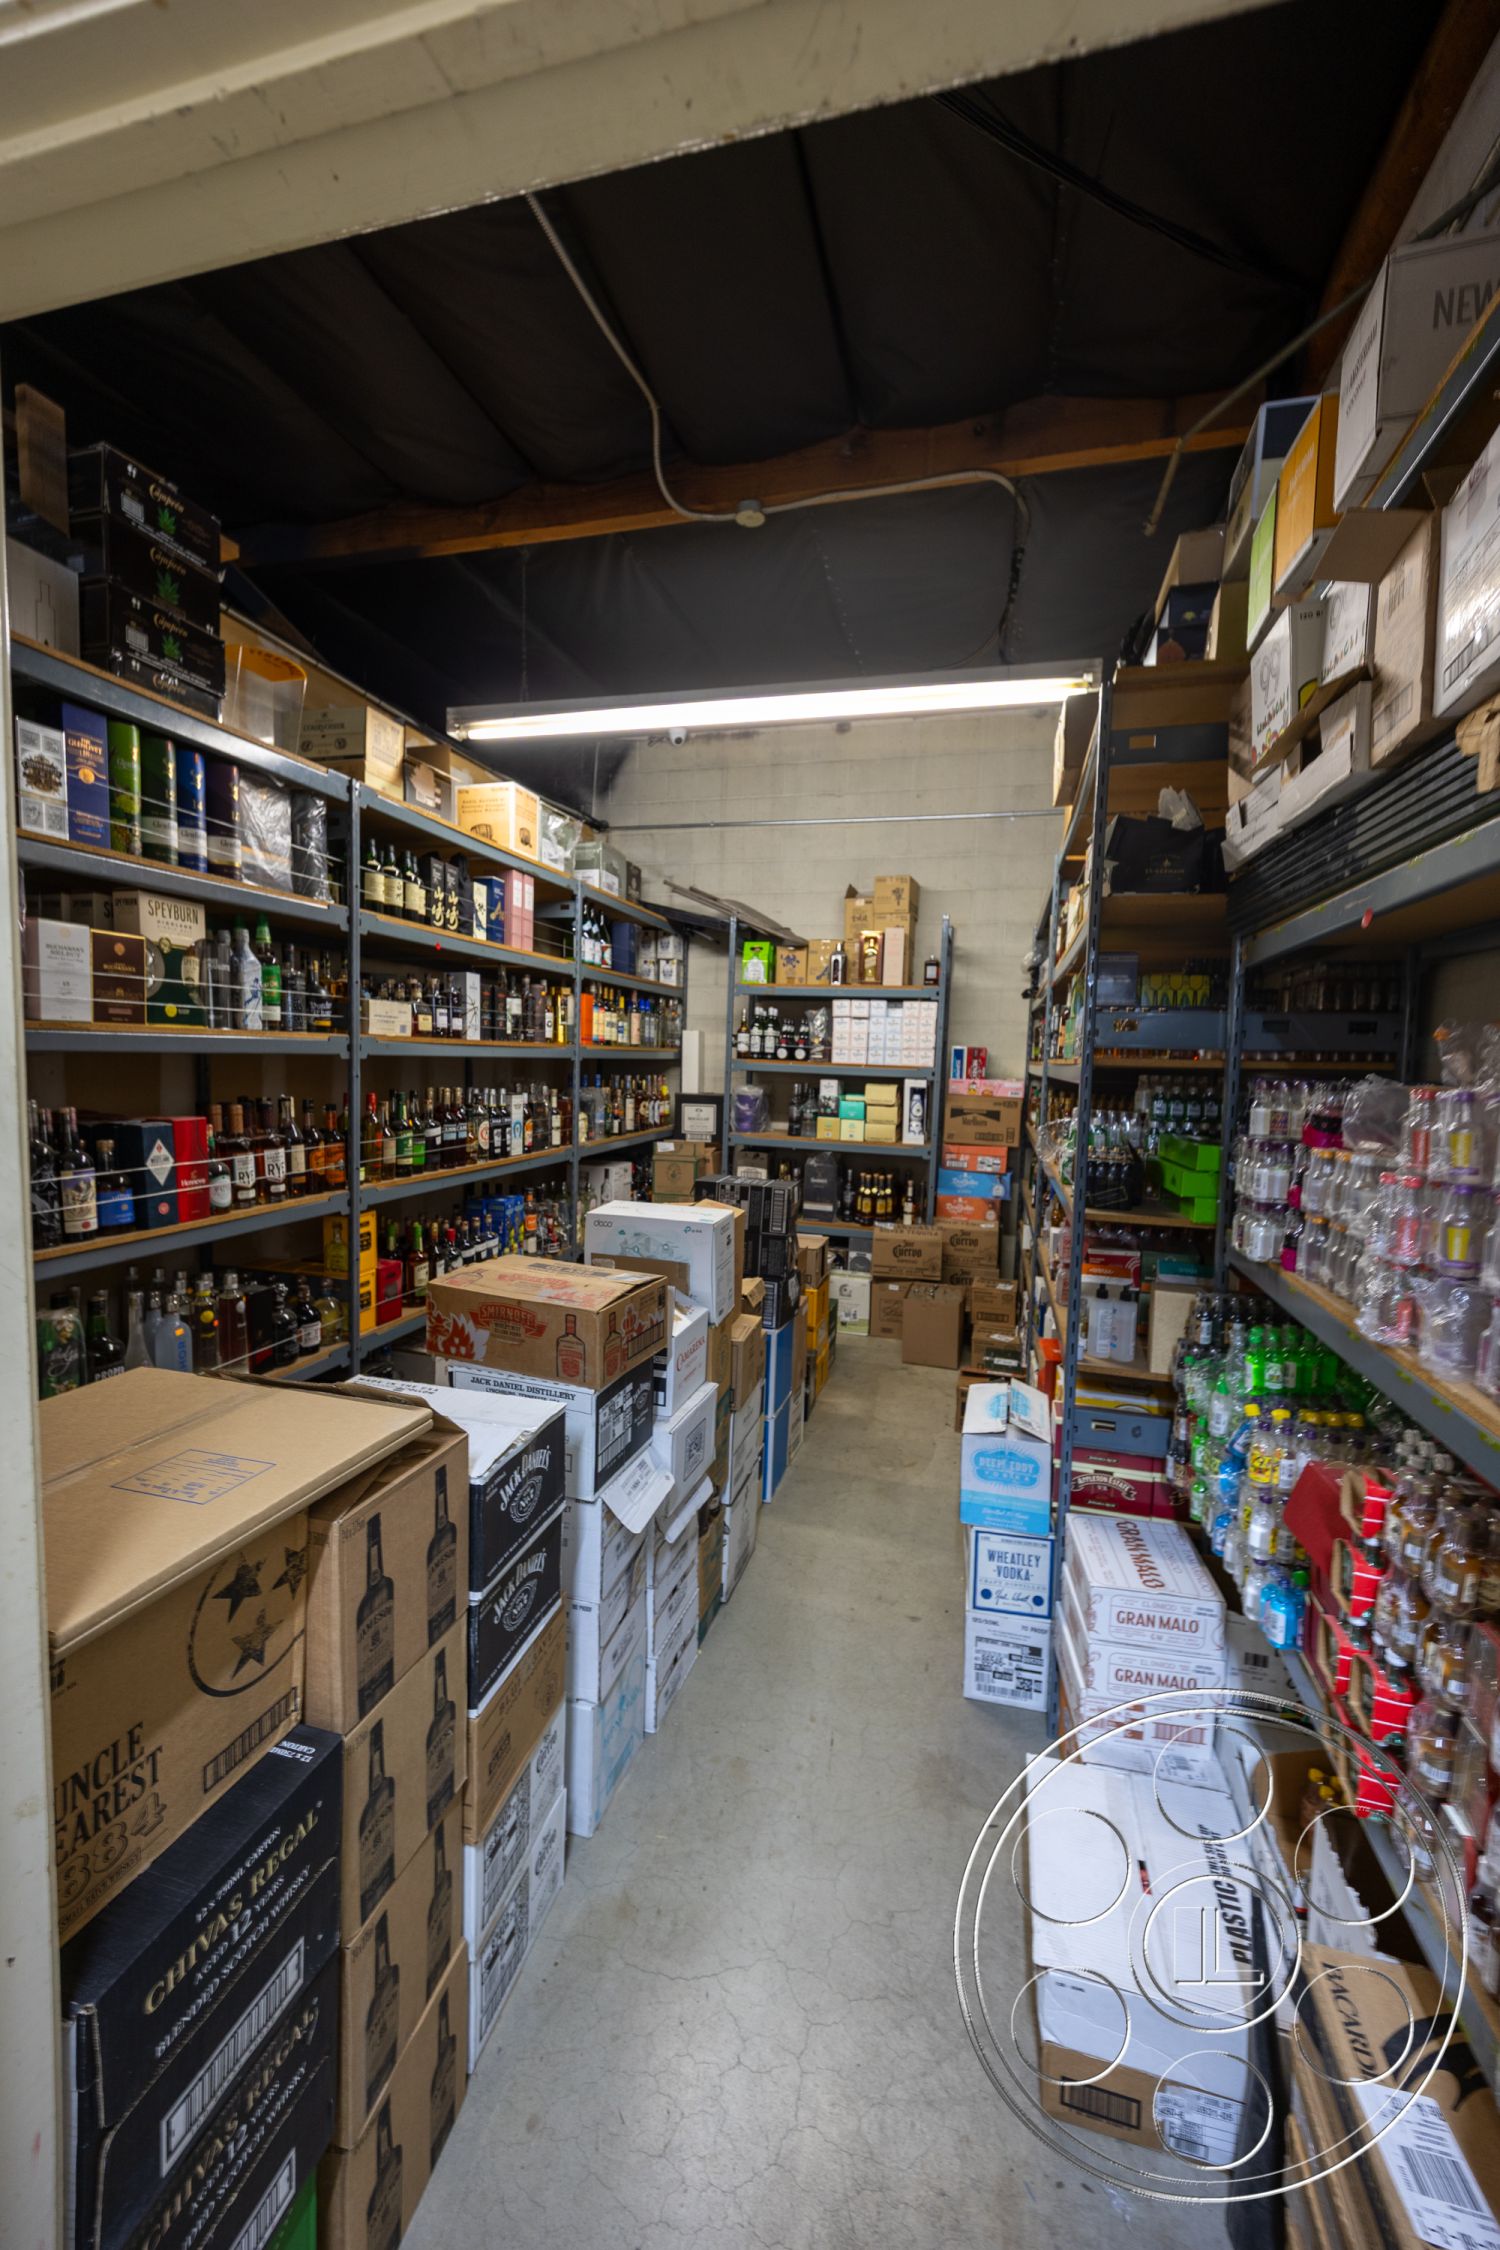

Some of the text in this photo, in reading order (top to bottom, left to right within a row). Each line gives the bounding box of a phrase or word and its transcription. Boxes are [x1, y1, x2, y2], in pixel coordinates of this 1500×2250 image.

[148, 899, 199, 925] SPEYBURN
[593, 1219, 613, 1229] deco
[892, 1244, 922, 1258] Cuervo
[949, 1234, 979, 1248] Cuervo
[480, 1304, 537, 1328] SMIRNOFF
[470, 1376, 577, 1402] JACK DANIEL DISTILLERY
[979, 1456, 1006, 1470] DEEP
[500, 1445, 552, 1511] JACK DANIEL'S
[1077, 1475, 1130, 1492] APPLETON ESTATE
[987, 1549, 1041, 1569] WHEATLEY
[1116, 1520, 1165, 1589] GRAN MALO
[493, 1547, 548, 1625] JACK DANIEL'S
[1116, 1610, 1199, 1634] GRAN MALO
[1114, 1667, 1198, 1690] GRAN MALO
[279, 1741, 316, 1755] CARTON
[54, 1722, 146, 1825] UNCLE
[246, 1826, 281, 1868] CARTON
[144, 1807, 320, 2016] CHIVAS REGAL
[1213, 1880, 1254, 1965] PLASTIC
[193, 1874, 285, 1987] AGED 12 YEARS
[155, 1863, 311, 2060] BLENDED SCOTCH WHISKY
[227, 2123, 248, 2163] 12
